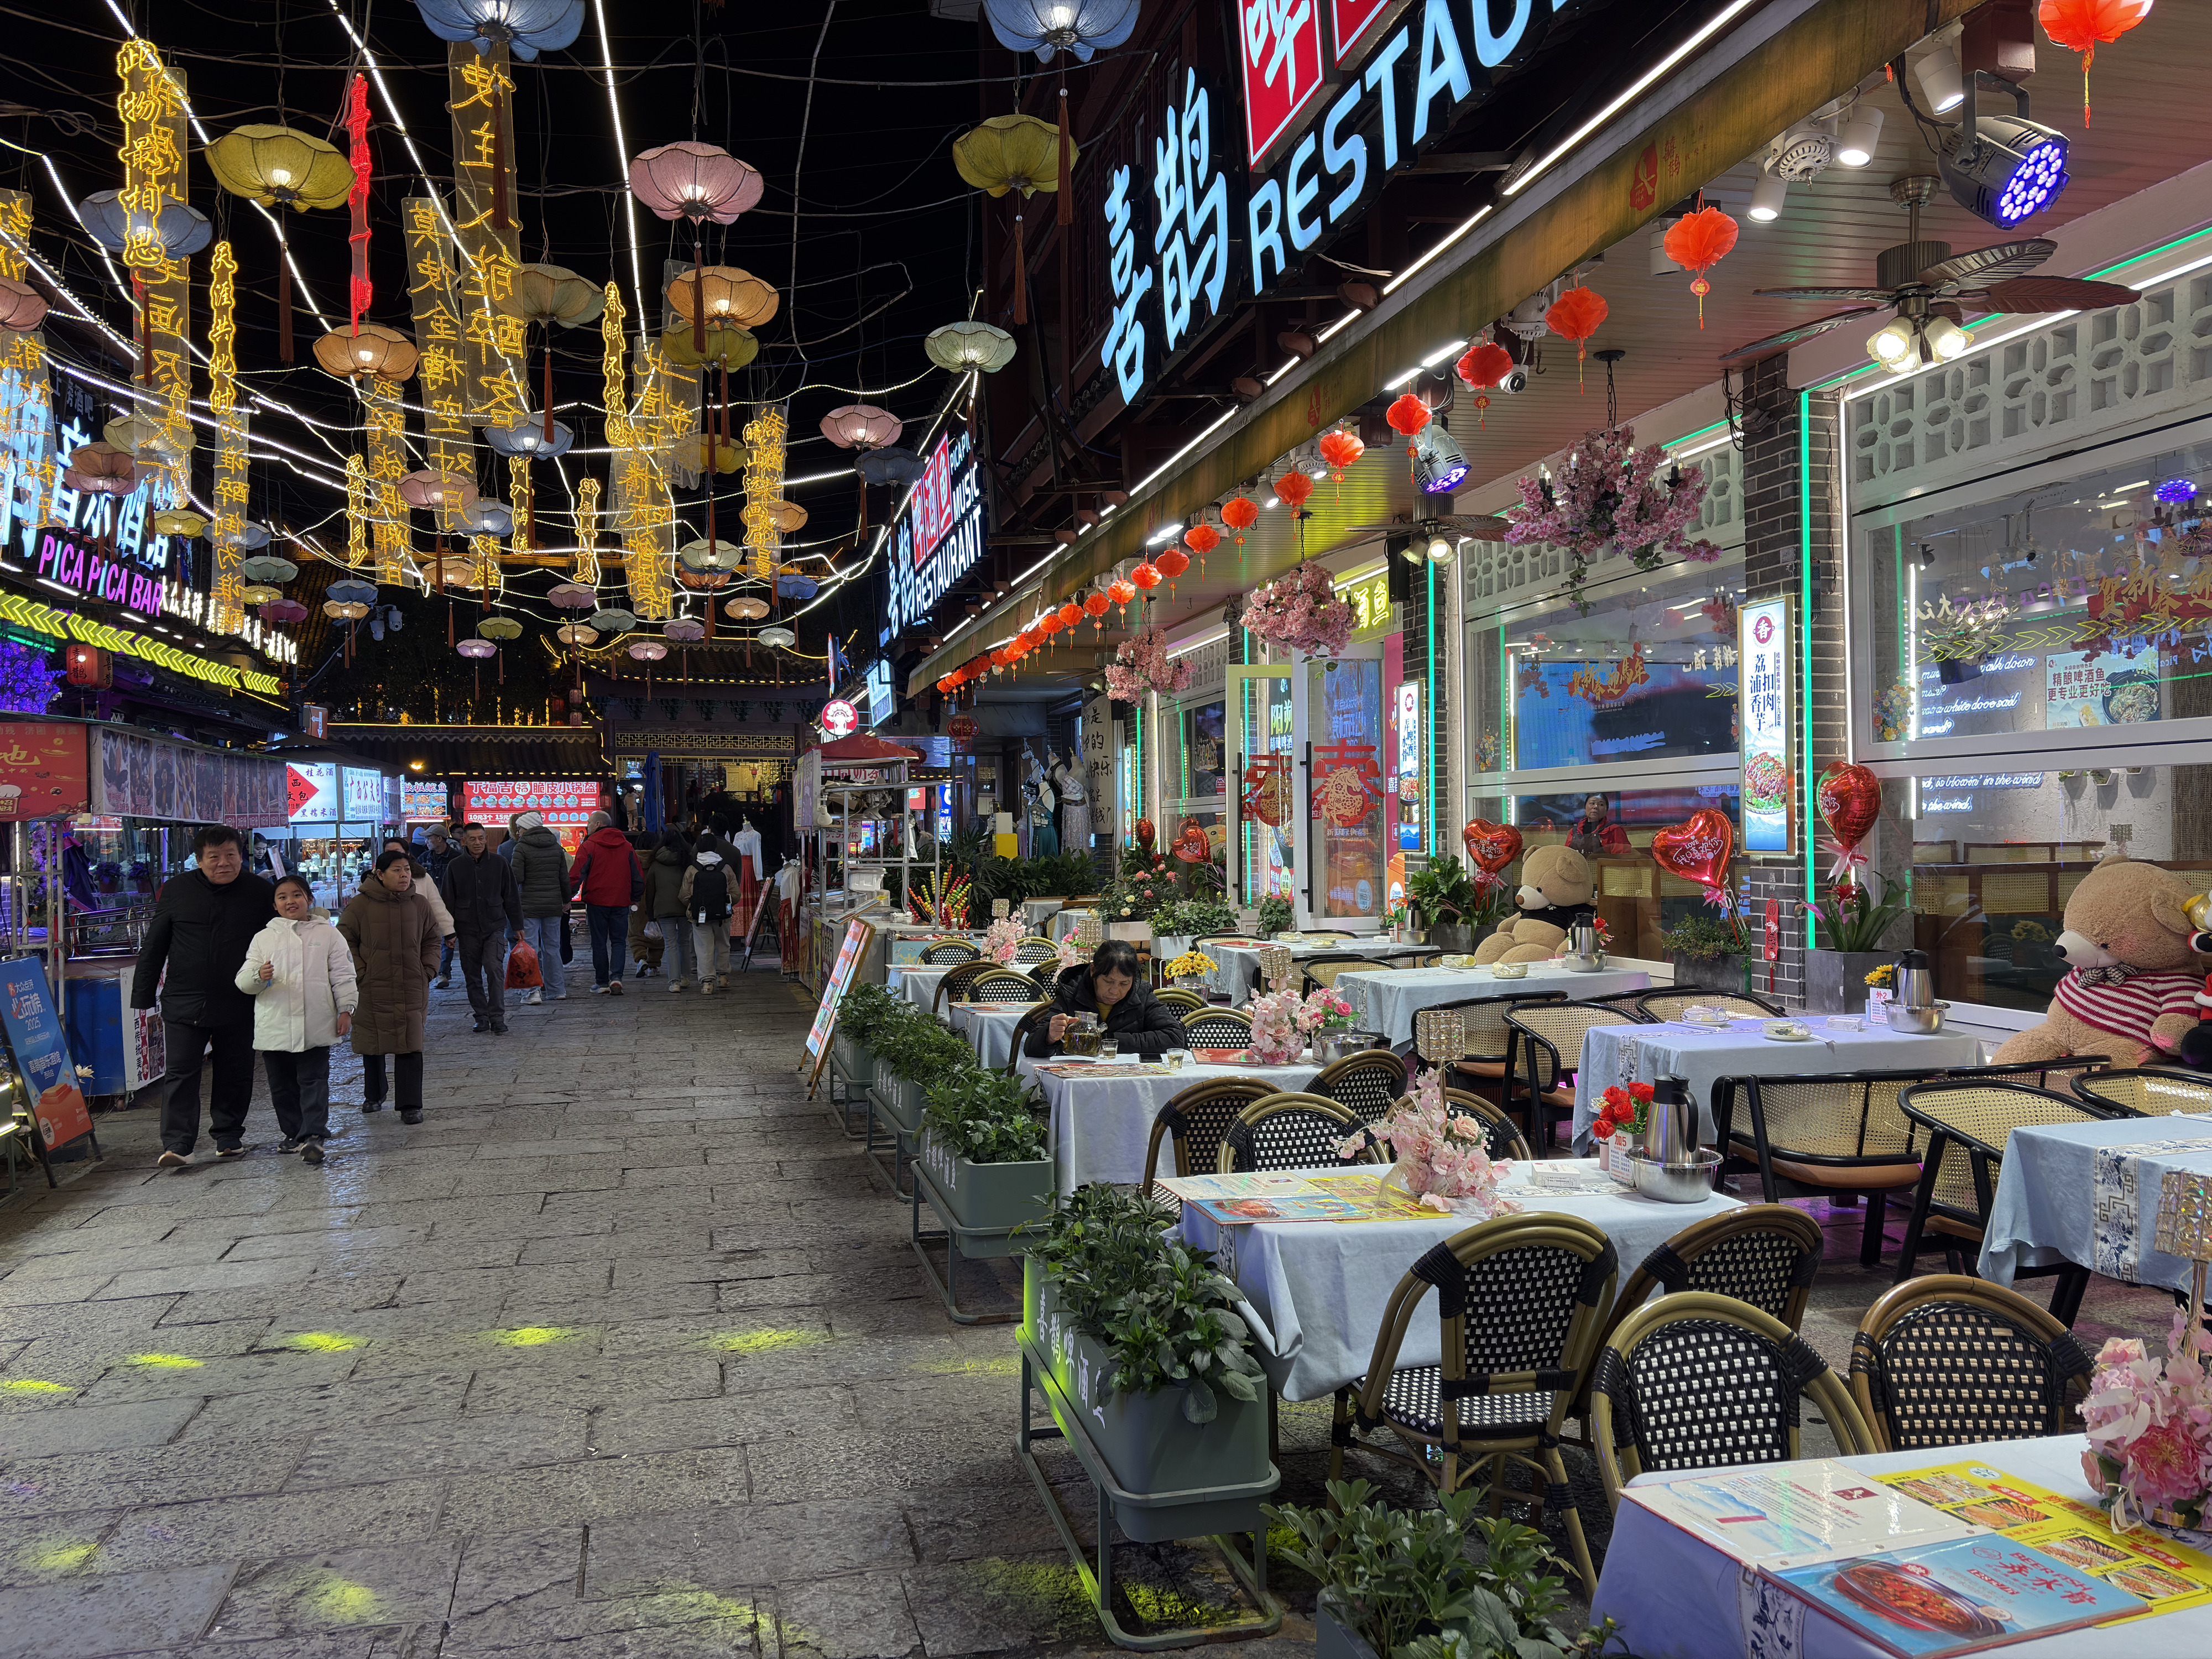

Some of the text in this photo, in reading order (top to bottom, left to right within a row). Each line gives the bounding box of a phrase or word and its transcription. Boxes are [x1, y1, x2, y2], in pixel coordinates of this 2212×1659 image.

[123, 48, 164, 262] 此物最相思
[1249, 0, 1568, 296] RESTAU
[1102, 67, 1230, 406] 喜鹊
[211, 244, 236, 415] 天涯共此时
[604, 284, 625, 445] 春眠不觉晓
[952, 461, 980, 522] MUSIC
[915, 504, 982, 618] RESTAURANT
[39, 535, 163, 617] PICA PICA BAR
[159, 575, 203, 627] 大众点评
[2004, 654, 2036, 669] down
[2052, 667, 2106, 687] 精酿啤酒鱼
[1750, 654, 1766, 732] 荔浦香芋
[1762, 673, 1775, 712] 扣肉
[1944, 698, 1971, 714] white
[1971, 697, 1996, 711] dove
[1996, 691, 2018, 708] sail
[2047, 682, 2111, 702] 更专业更好吃
[305, 768, 334, 778] 桂花酒
[533, 781, 597, 794] 脆皮小锅盔
[1983, 775, 1993, 786] in
[1995, 773, 2012, 786] the
[2012, 771, 2042, 785] wind
[349, 775, 382, 804] 广西公文包
[300, 807, 337, 818] 黑糯米酒
[1928, 799, 1943, 811] the
[1684, 837, 1699, 850] LOVE
[1876, 990, 1887, 1000] 外2
[25, 1016, 41, 1031] 2025
[133, 1010, 143, 1083] 西传统美食
[1614, 1133, 1627, 1147] 加5
[2009, 1552, 2093, 1594] BEER FISH
